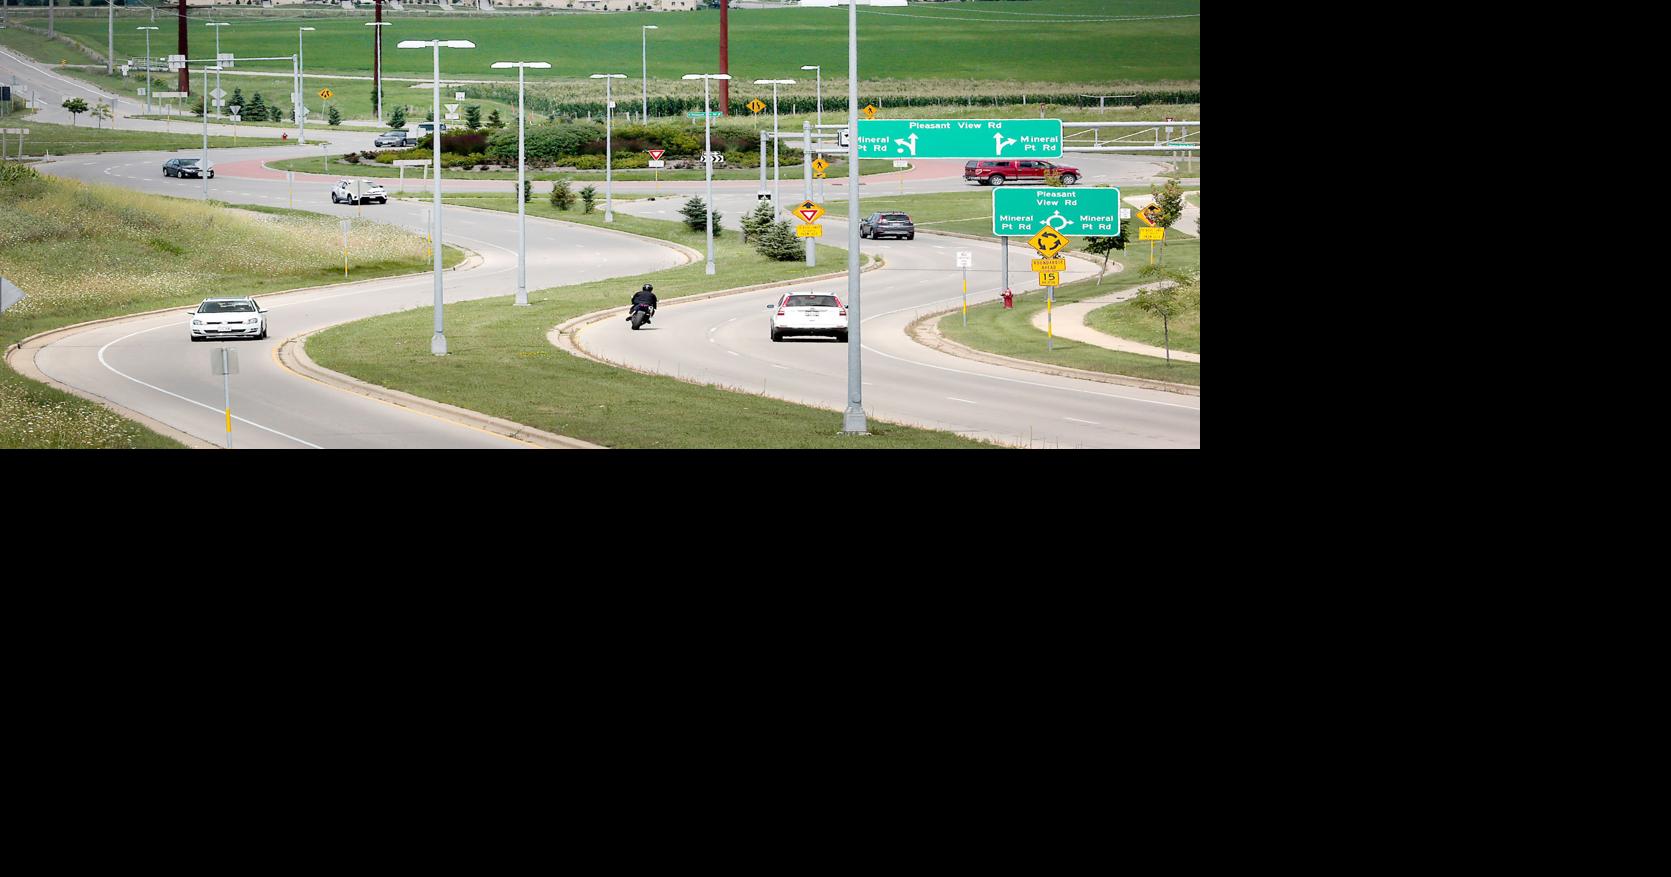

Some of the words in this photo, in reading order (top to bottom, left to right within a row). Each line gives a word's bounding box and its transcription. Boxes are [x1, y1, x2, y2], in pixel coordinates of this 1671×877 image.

[908, 121, 950, 129] Pleasant
[958, 121, 982, 129] View
[987, 121, 1002, 129] Rd
[1020, 135, 1058, 143] Mineral
[1043, 273, 1056, 281] 15
